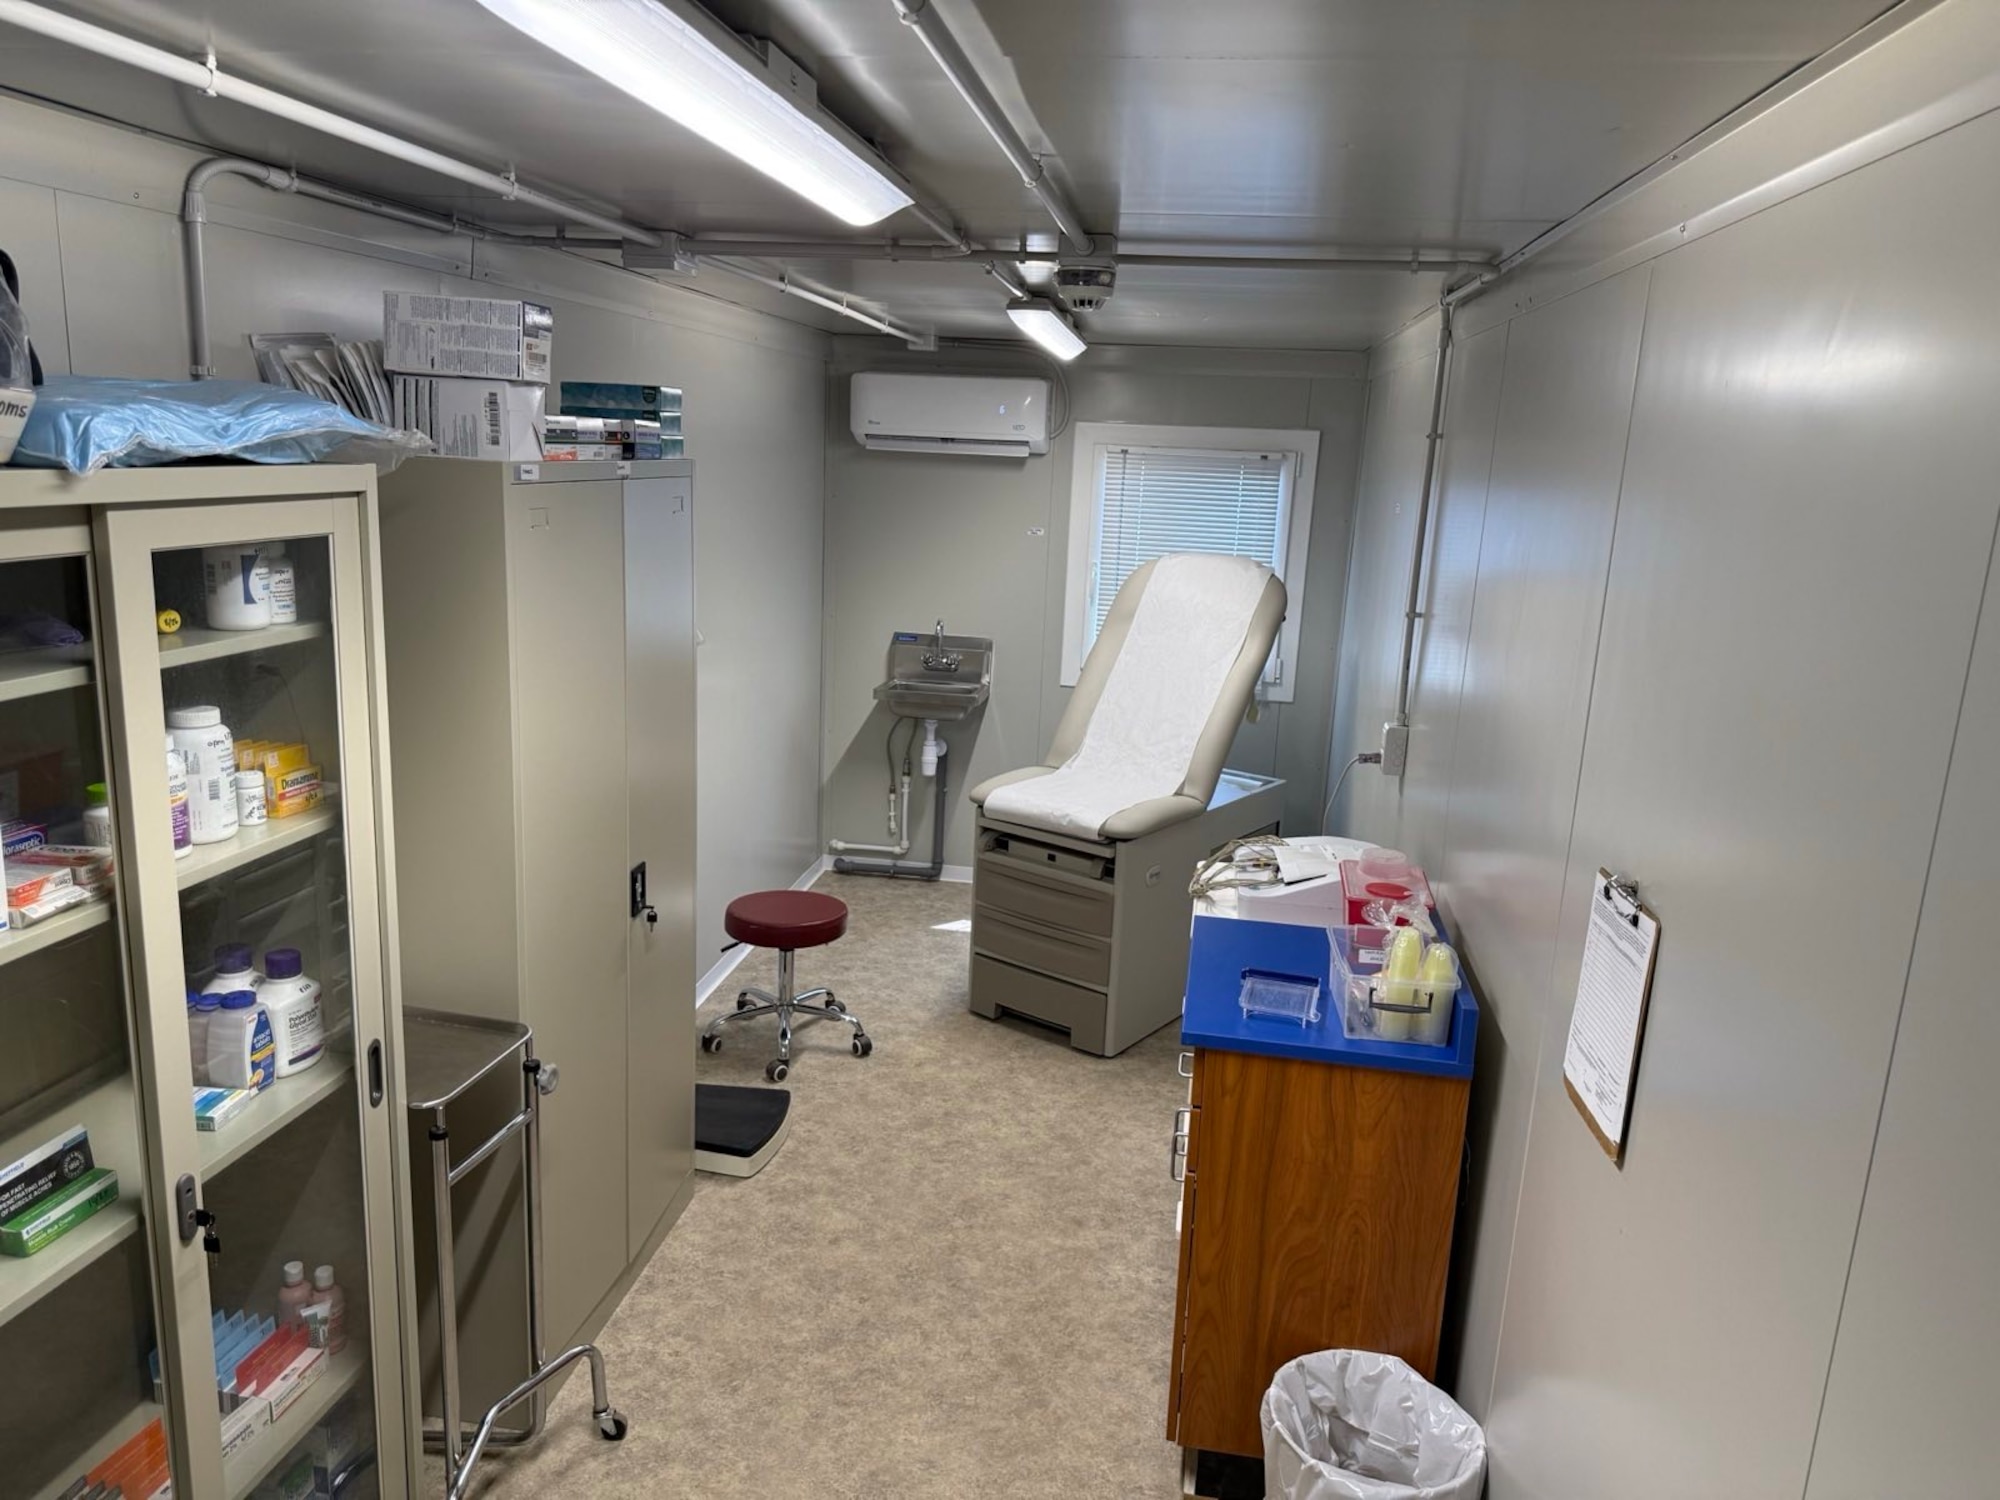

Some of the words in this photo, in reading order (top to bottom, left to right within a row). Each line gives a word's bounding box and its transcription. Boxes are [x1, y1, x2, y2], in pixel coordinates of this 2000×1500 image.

[38, 1170, 57, 1187] RELIEF
[10, 1183, 26, 1196] FAST
[0, 1208, 9, 1218] OF
[10, 1194, 34, 1214] MUSCLE
[33, 1181, 53, 1197] ACHES
